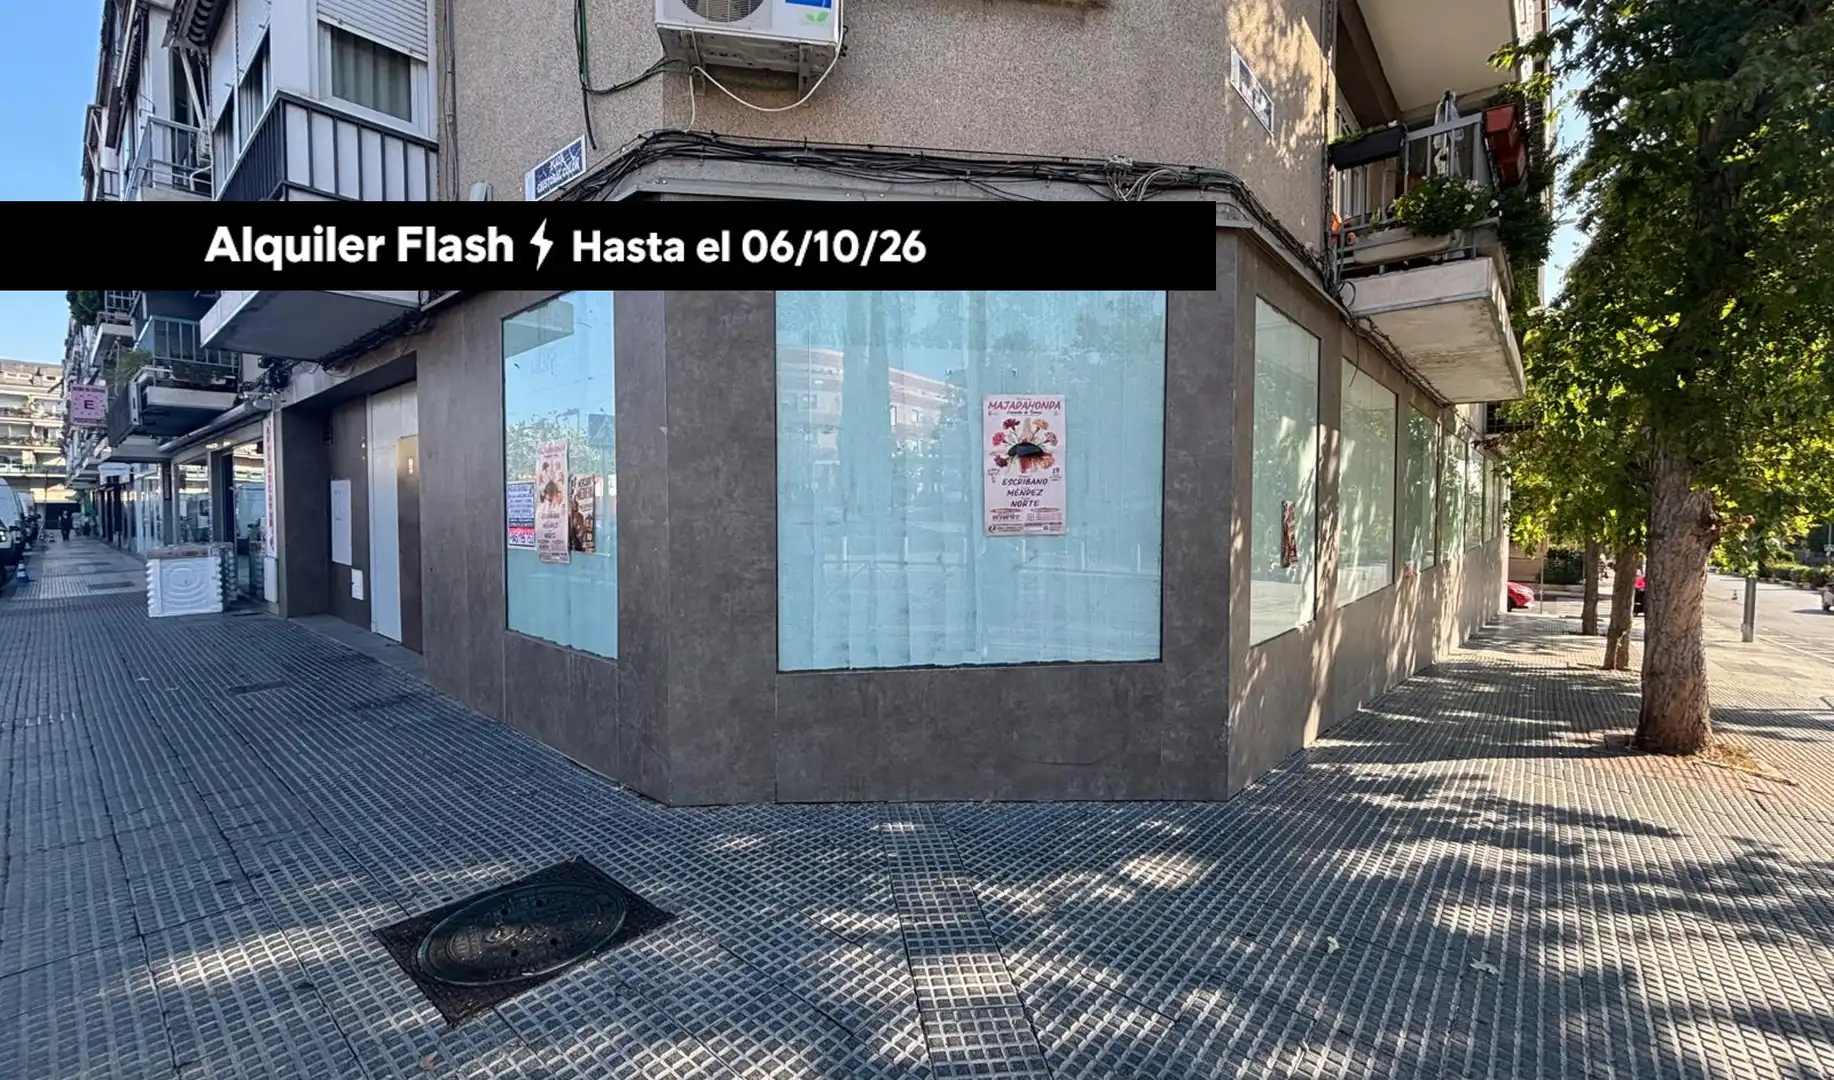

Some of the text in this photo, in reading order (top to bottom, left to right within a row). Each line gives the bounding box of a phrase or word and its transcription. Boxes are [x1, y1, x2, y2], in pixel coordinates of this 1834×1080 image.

[84, 400, 95, 410] E
[988, 401, 1061, 410] MAJADAHONDA
[1002, 478, 1048, 486] ESCRIBANO
[1006, 488, 1044, 496] MÉNDEZ
